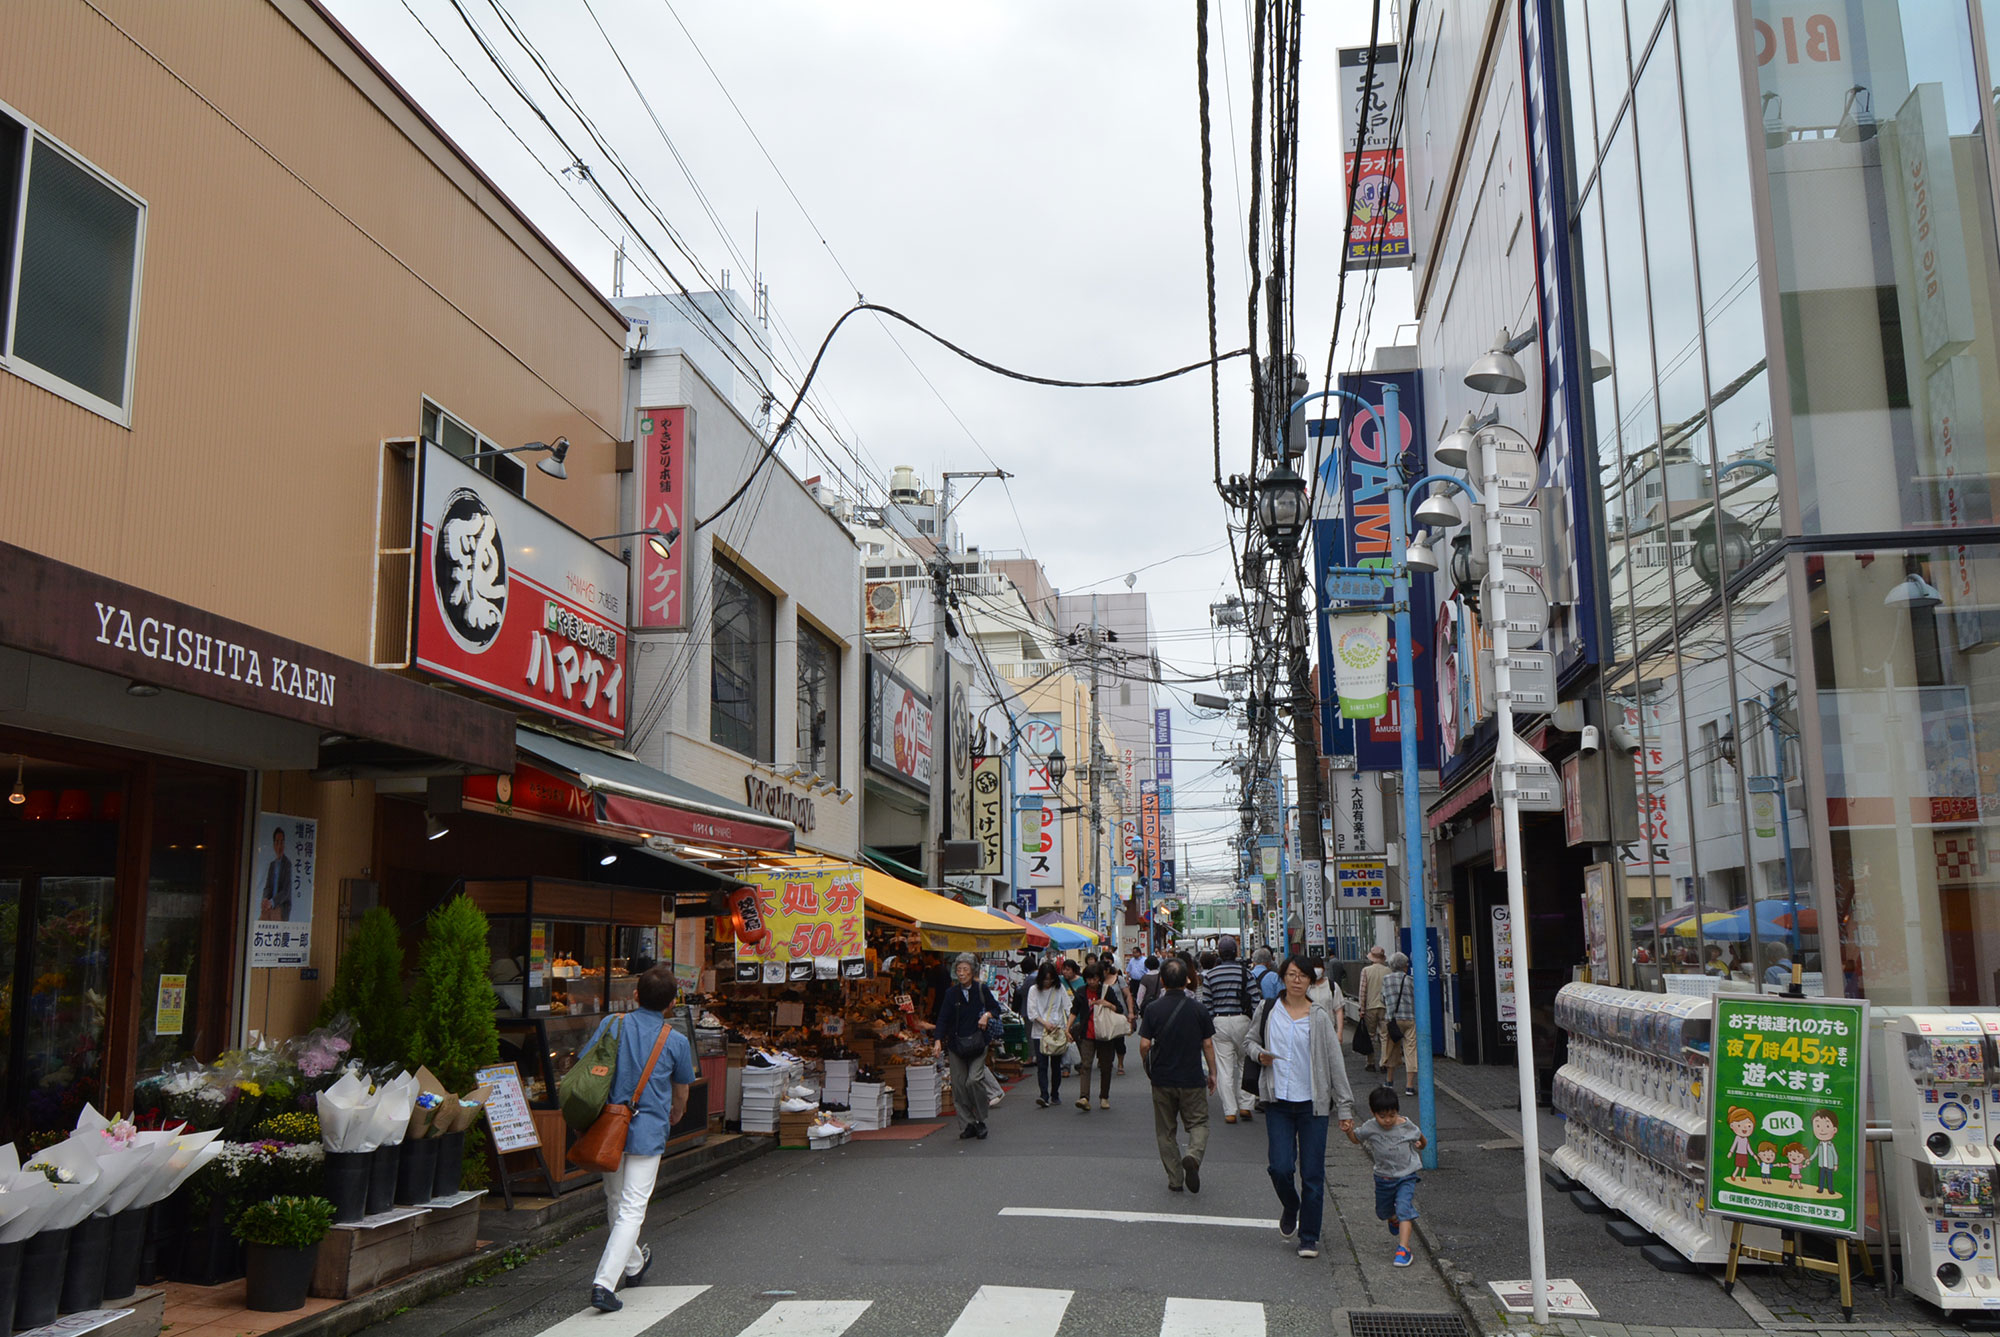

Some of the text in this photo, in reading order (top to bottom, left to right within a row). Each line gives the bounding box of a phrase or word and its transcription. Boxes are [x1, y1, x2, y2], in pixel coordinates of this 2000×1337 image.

[1351, 222, 1405, 240] 歌広場
[1352, 242, 1406, 256] 受付4F
[660, 418, 672, 493] やきとり本舗
[648, 503, 678, 619] ハケイ
[95, 601, 336, 706] YAGISHITA KAEN
[525, 630, 623, 719] ハマケイ
[1160, 711, 1168, 743] YAMAHA
[745, 775, 816, 833] YOKOHAMAYA
[1351, 787, 1365, 833] 大成有楽
[1337, 834, 1345, 851] 3F
[767, 871, 831, 881] ブランドスニーカー
[833, 872, 861, 885] SALE
[1339, 869, 1385, 880] 国大Qゼミ
[1343, 887, 1381, 897] 理英会
[253, 931, 310, 948] あさお慶一郎
[1728, 1014, 1848, 1036] お子様連れの方も
[1742, 1063, 1832, 1095] 遊べます。
[1769, 1117, 1795, 1129] OK!
